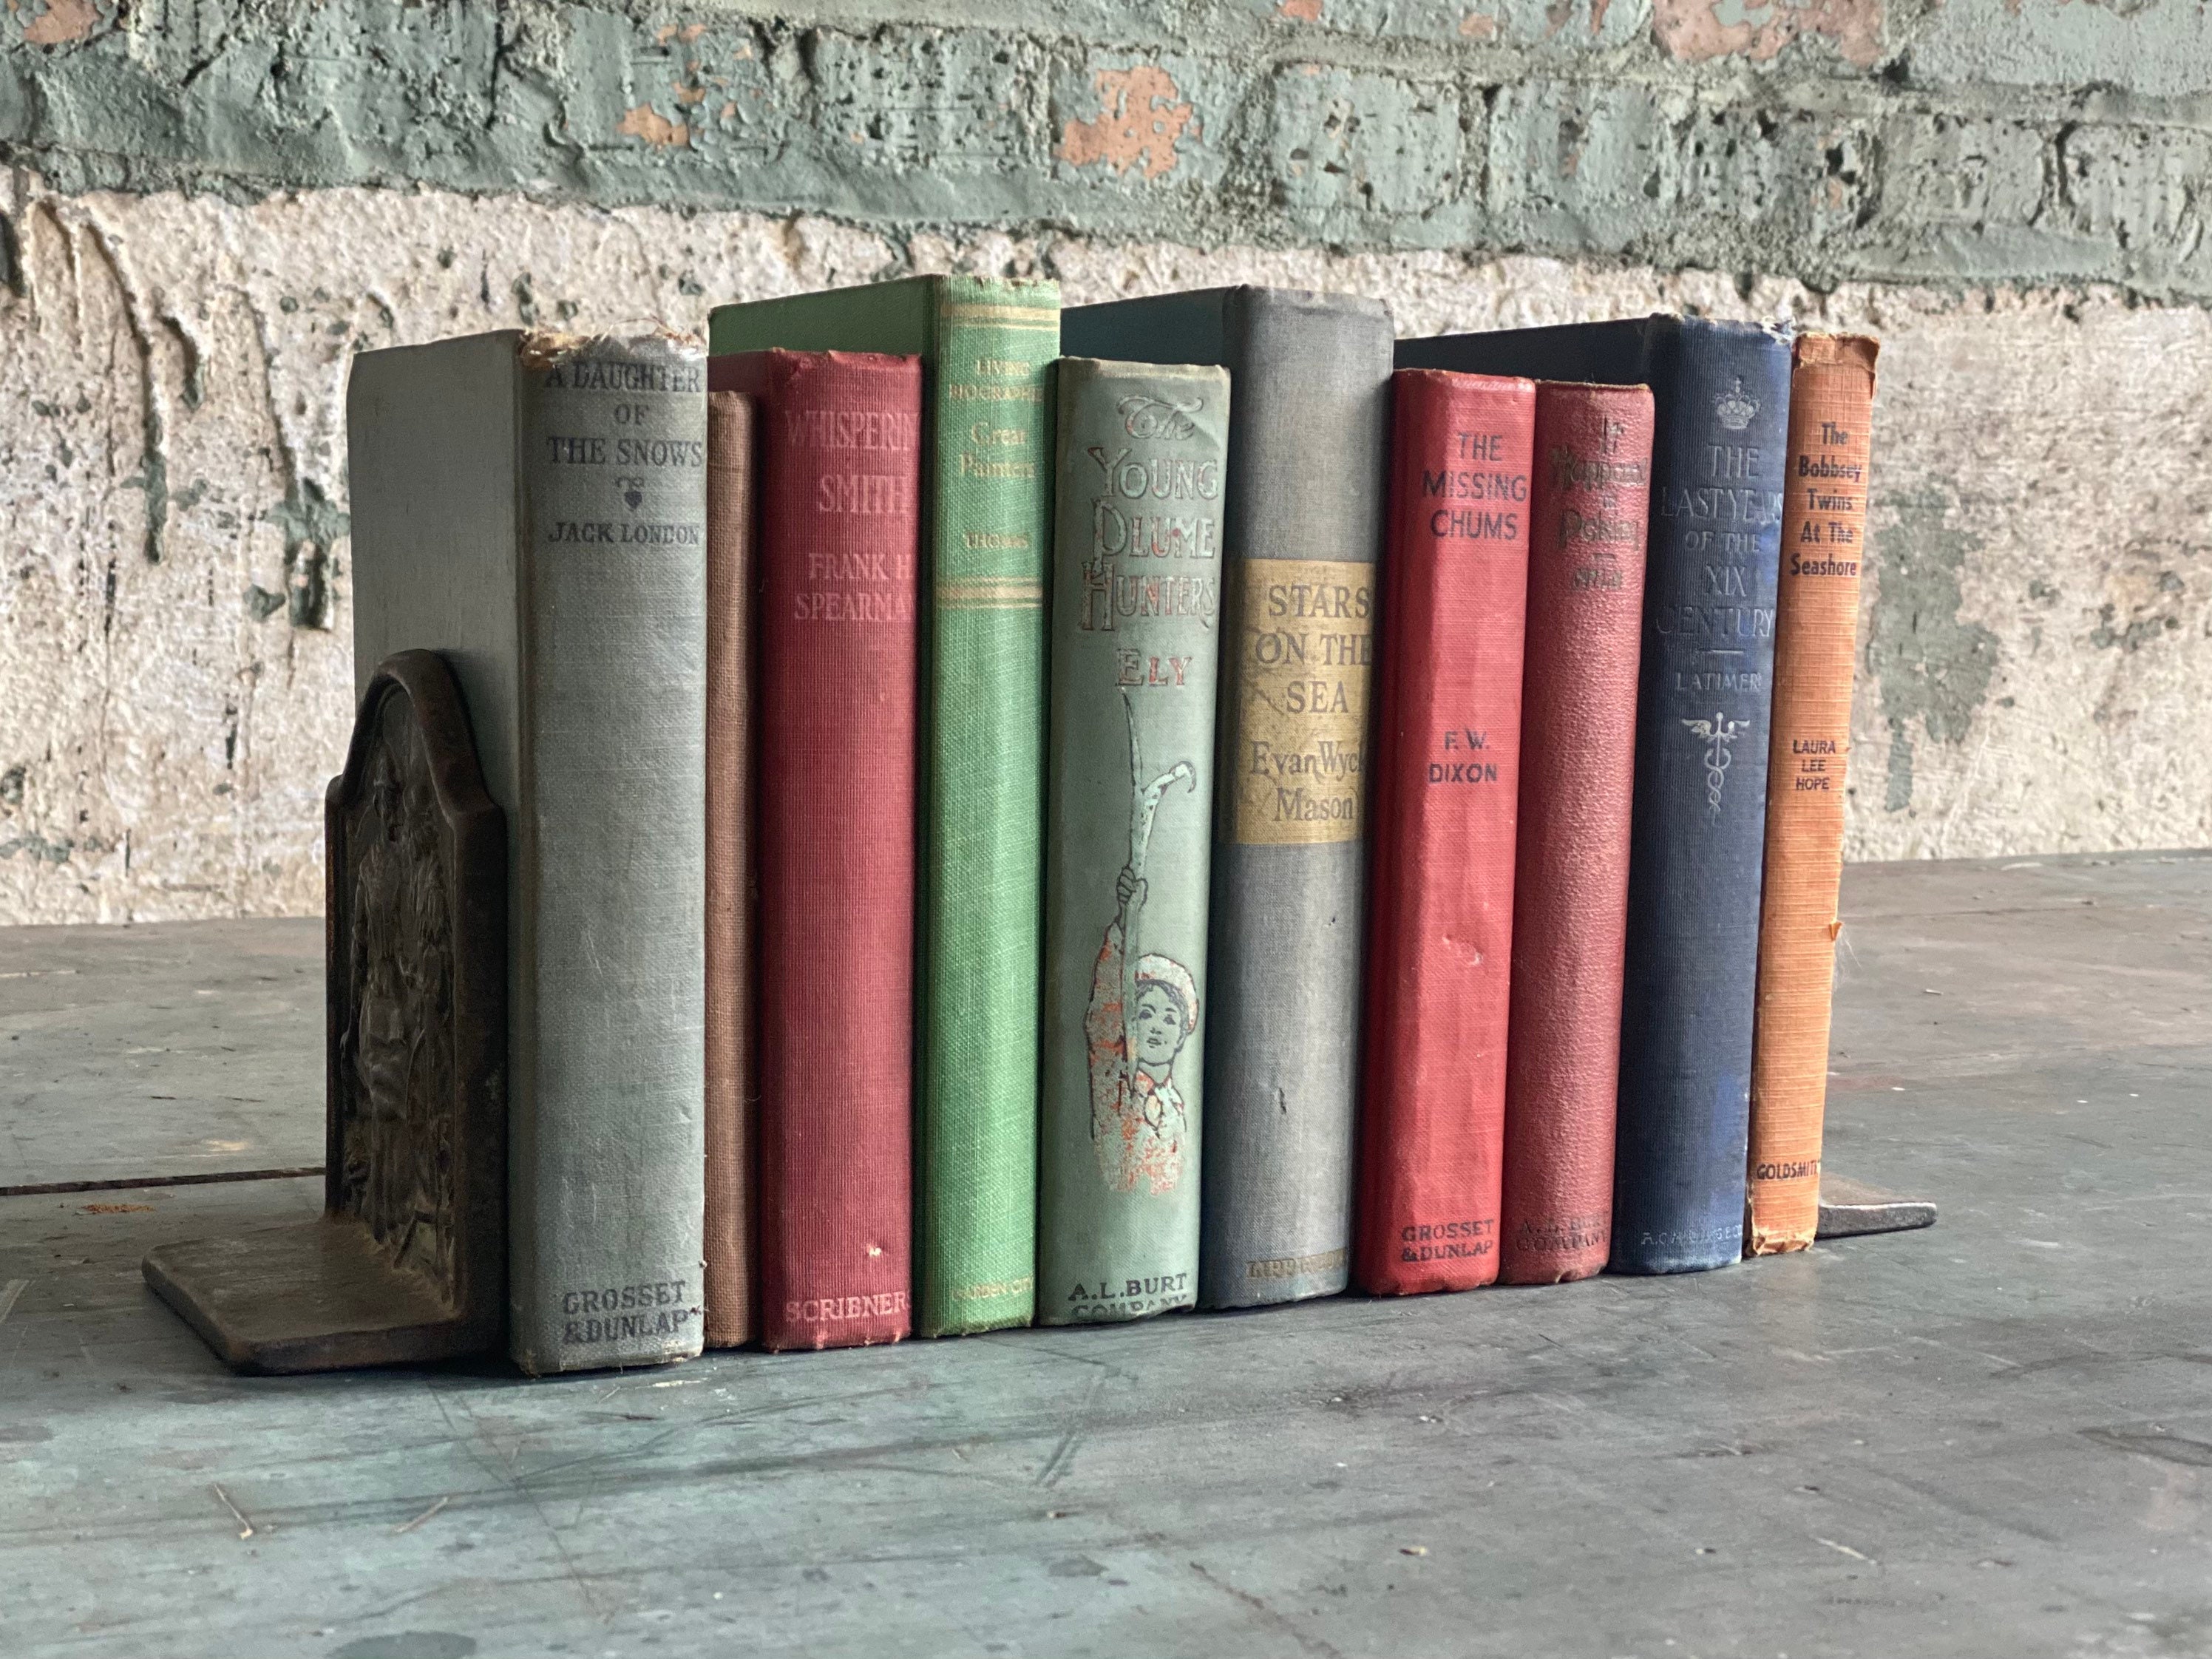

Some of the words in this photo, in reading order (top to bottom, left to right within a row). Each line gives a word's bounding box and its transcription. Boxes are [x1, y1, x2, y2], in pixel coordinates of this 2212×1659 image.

[545, 363, 564, 389] A
[572, 360, 702, 393] DAUGHTER
[613, 403, 649, 426] OF
[1116, 393, 1204, 440] The
[1458, 431, 1504, 461] THE
[1822, 421, 1849, 445] The
[545, 435, 607, 466] THE
[616, 438, 703, 467] SNOWS
[1708, 445, 1762, 478] THE
[1086, 447, 1219, 501] YOUNG
[1798, 454, 1863, 483] Bobbsey
[818, 473, 909, 515] SMITH
[1422, 469, 1527, 502] MISSING
[1807, 488, 1853, 511] Twins
[546, 521, 615, 543] JACK
[620, 523, 701, 546] LONDON
[1089, 496, 1217, 579] PLUME
[1429, 509, 1518, 541] CHUMS
[1684, 529, 1715, 552] OF
[1723, 531, 1763, 553] THE
[1799, 520, 1822, 543] At
[1828, 521, 1854, 544] The
[807, 552, 889, 581] FRANK
[1704, 562, 1748, 598] XIX
[1789, 552, 1858, 577] Seashore
[793, 592, 915, 622] SPEARMA
[1079, 560, 1216, 631] HUNTERS
[1268, 583, 1371, 620] STARS
[1655, 604, 1775, 639] CENTURY
[1255, 632, 1307, 665] ON
[1319, 634, 1372, 666] THE
[1115, 648, 1193, 687] ELY
[1675, 671, 1763, 693] LATIMER
[1285, 679, 1351, 714] SEA
[1792, 739, 1836, 754] LAURA
[1428, 762, 1498, 784] DIXON
[1801, 759, 1827, 773] LEE
[1795, 776, 1831, 791] HOPE
[1271, 785, 1355, 822] Mason
[1400, 1218, 1495, 1244] GROSSET
[562, 1280, 686, 1315] GROSSET
[785, 1290, 910, 1323] SCRIBNER
